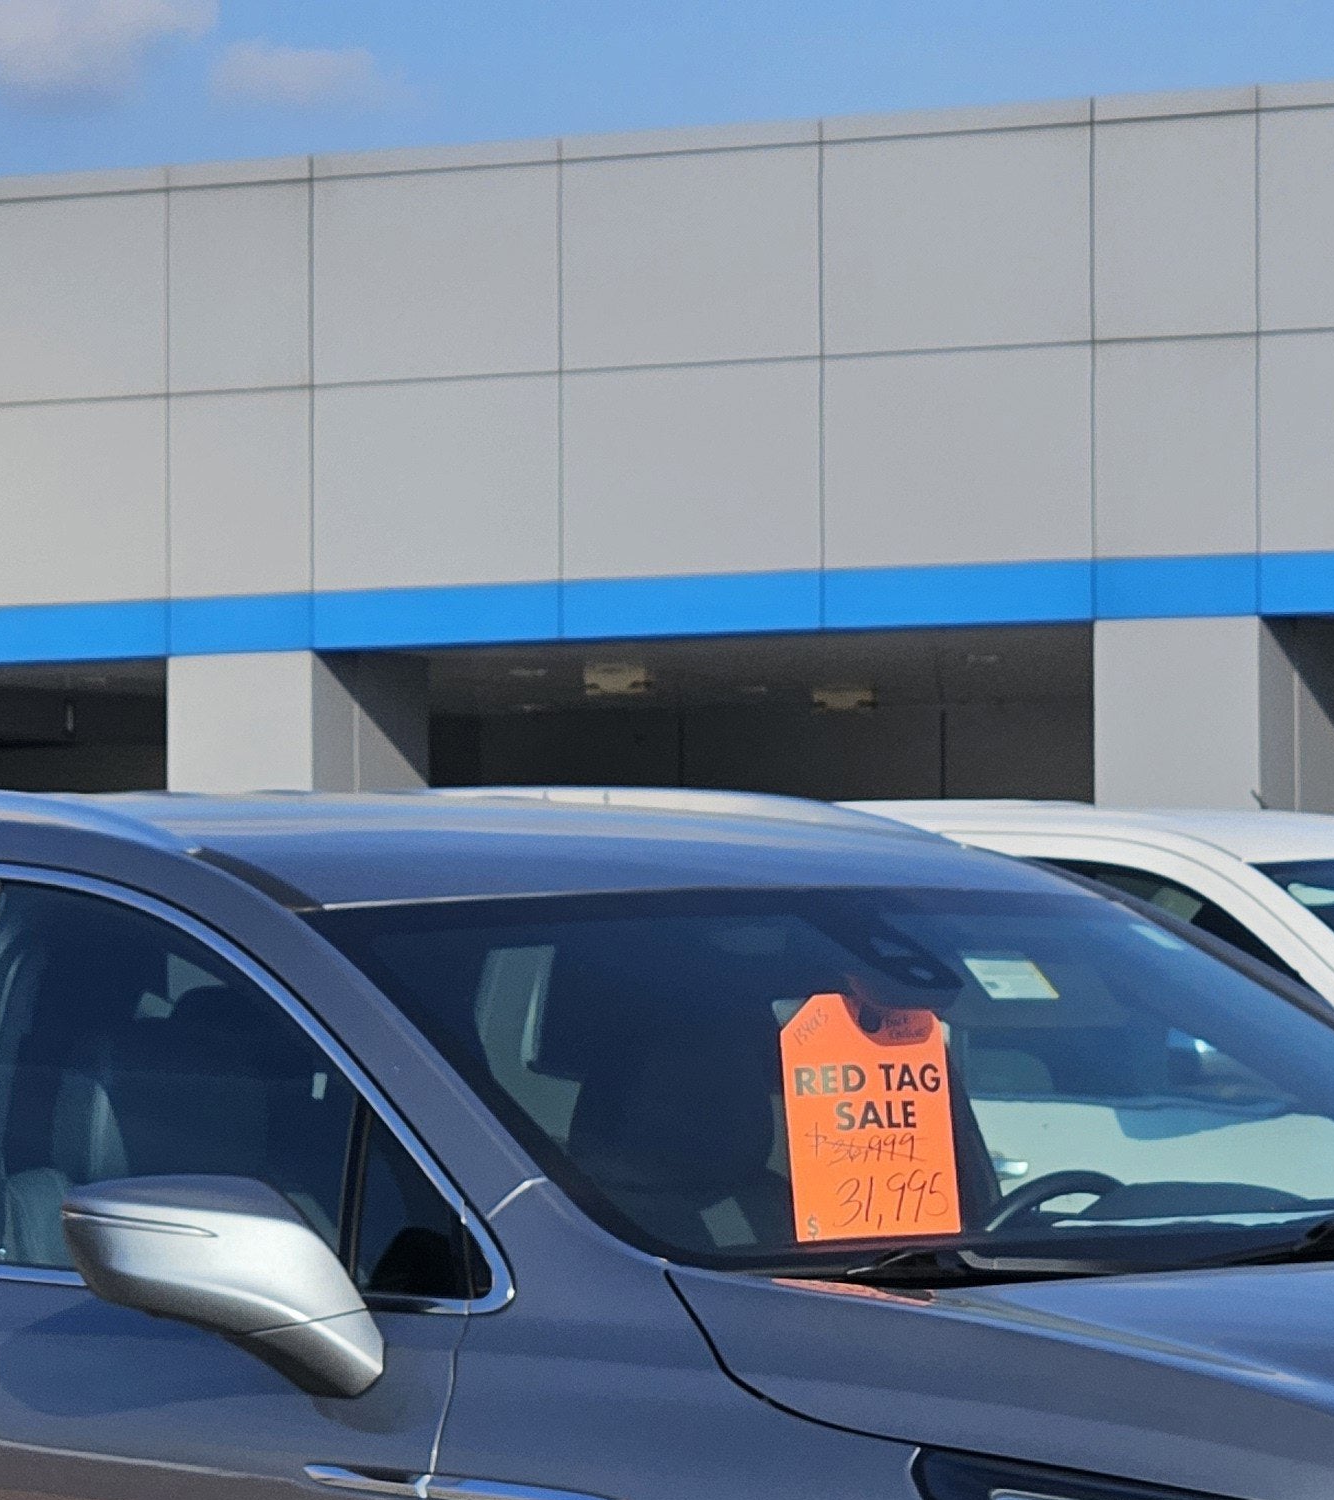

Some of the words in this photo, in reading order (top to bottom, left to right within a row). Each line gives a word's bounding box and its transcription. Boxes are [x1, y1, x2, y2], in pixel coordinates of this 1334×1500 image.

[794, 1064, 866, 1096] RED
[878, 1063, 941, 1093] TAG
[835, 1100, 917, 1131] SALE
[833, 1168, 949, 1230] 31,995
